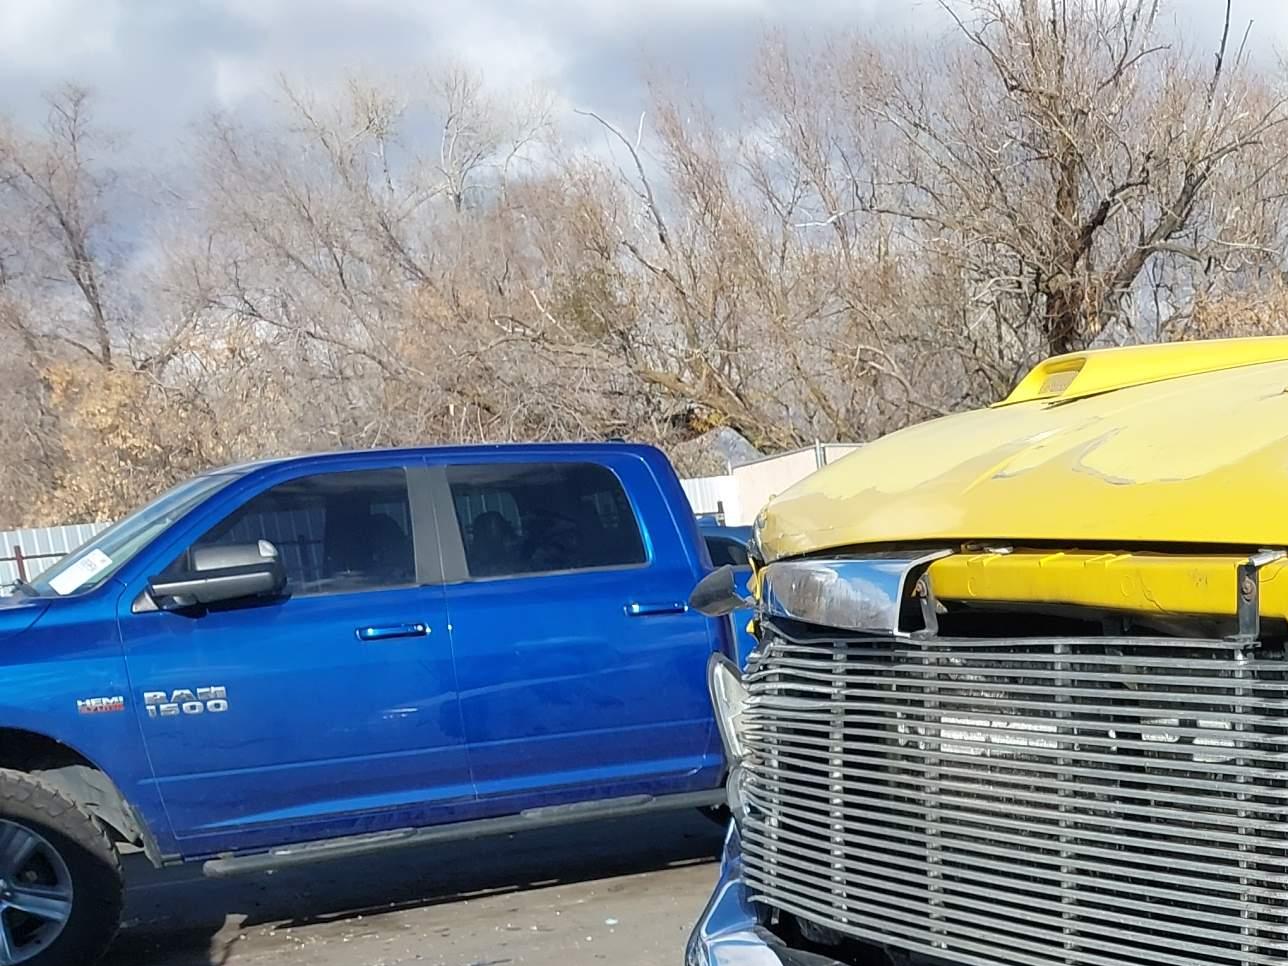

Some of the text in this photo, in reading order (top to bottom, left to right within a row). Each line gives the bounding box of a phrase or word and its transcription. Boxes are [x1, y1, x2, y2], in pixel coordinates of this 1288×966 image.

[77, 695, 124, 707] HEMI
[143, 686, 227, 704] RAM
[145, 699, 229, 718] 1500
